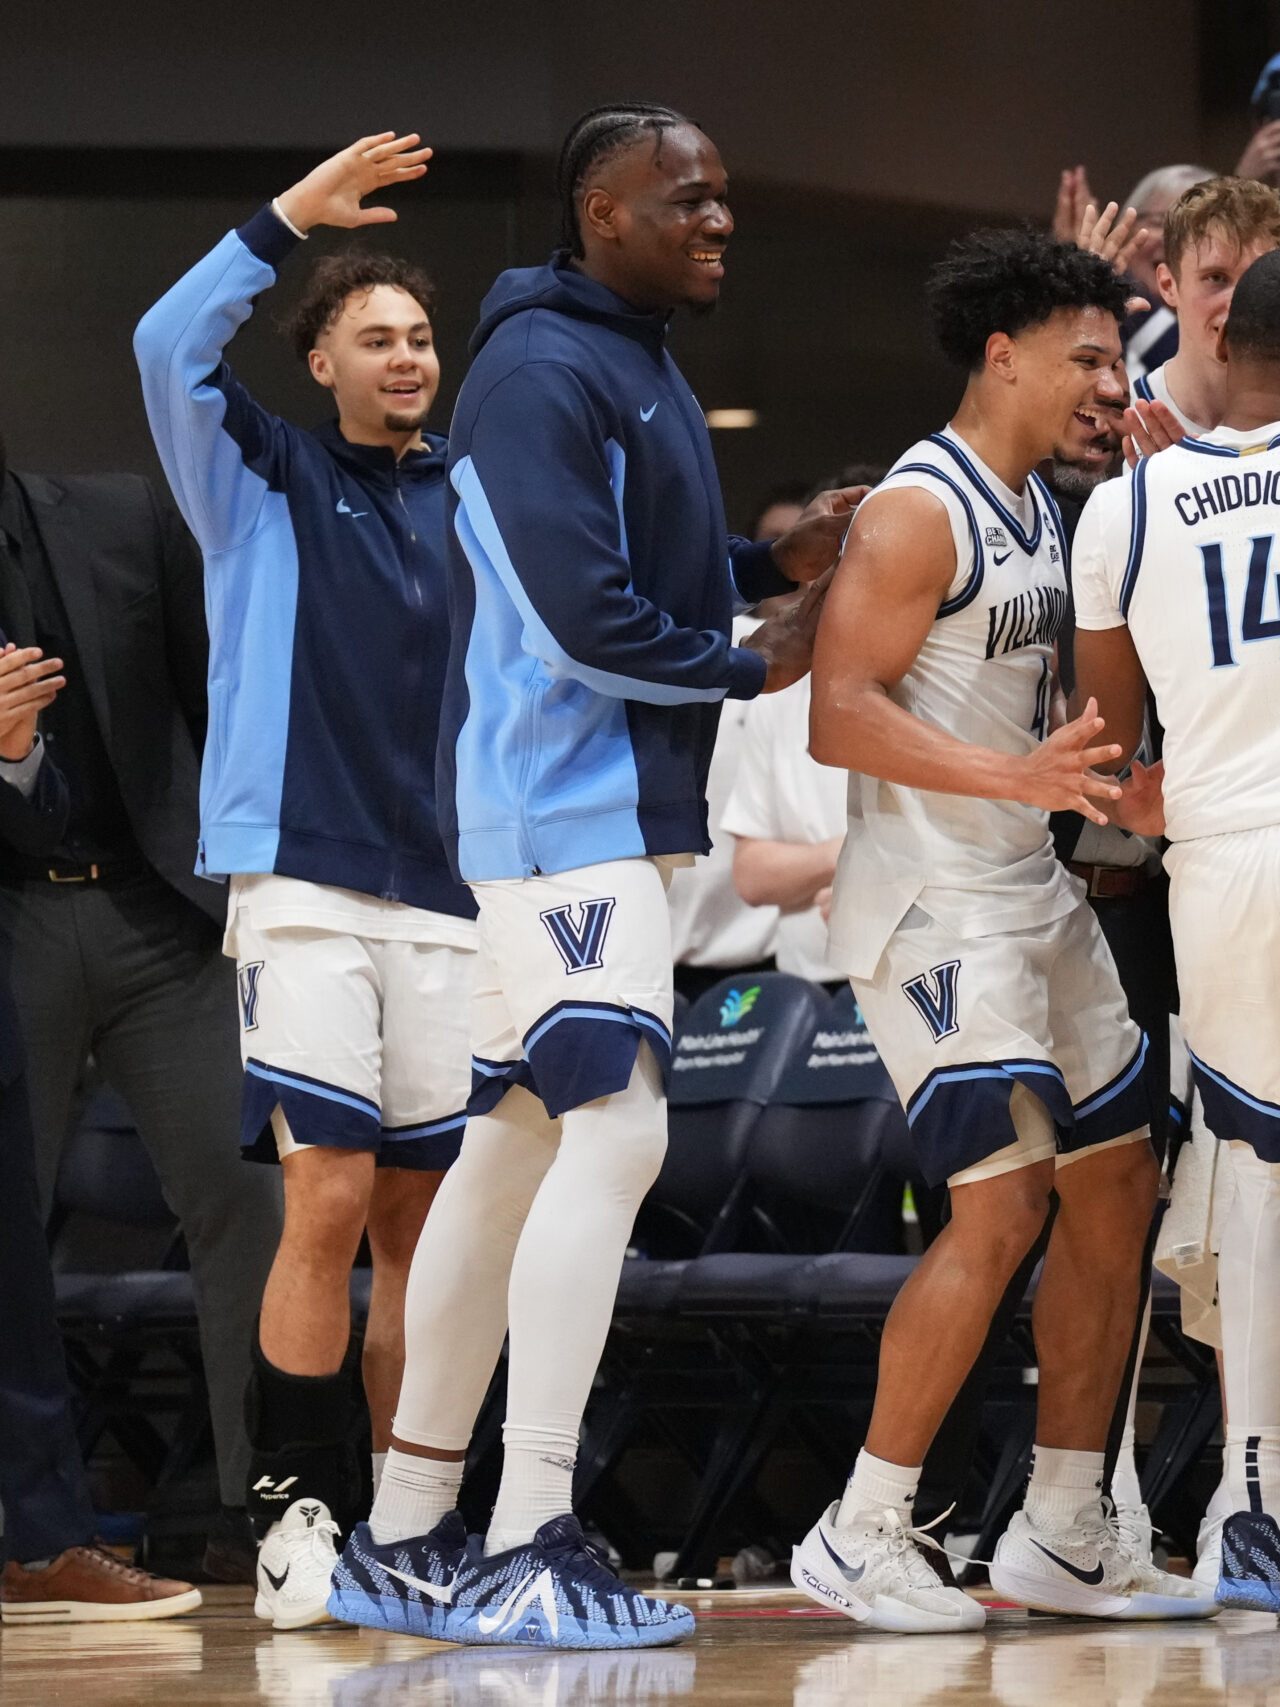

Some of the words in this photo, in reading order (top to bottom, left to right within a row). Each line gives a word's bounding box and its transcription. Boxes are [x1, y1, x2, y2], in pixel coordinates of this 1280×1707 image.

[540, 897, 616, 975] V
[237, 960, 265, 1033] V
[901, 959, 962, 1044] V
